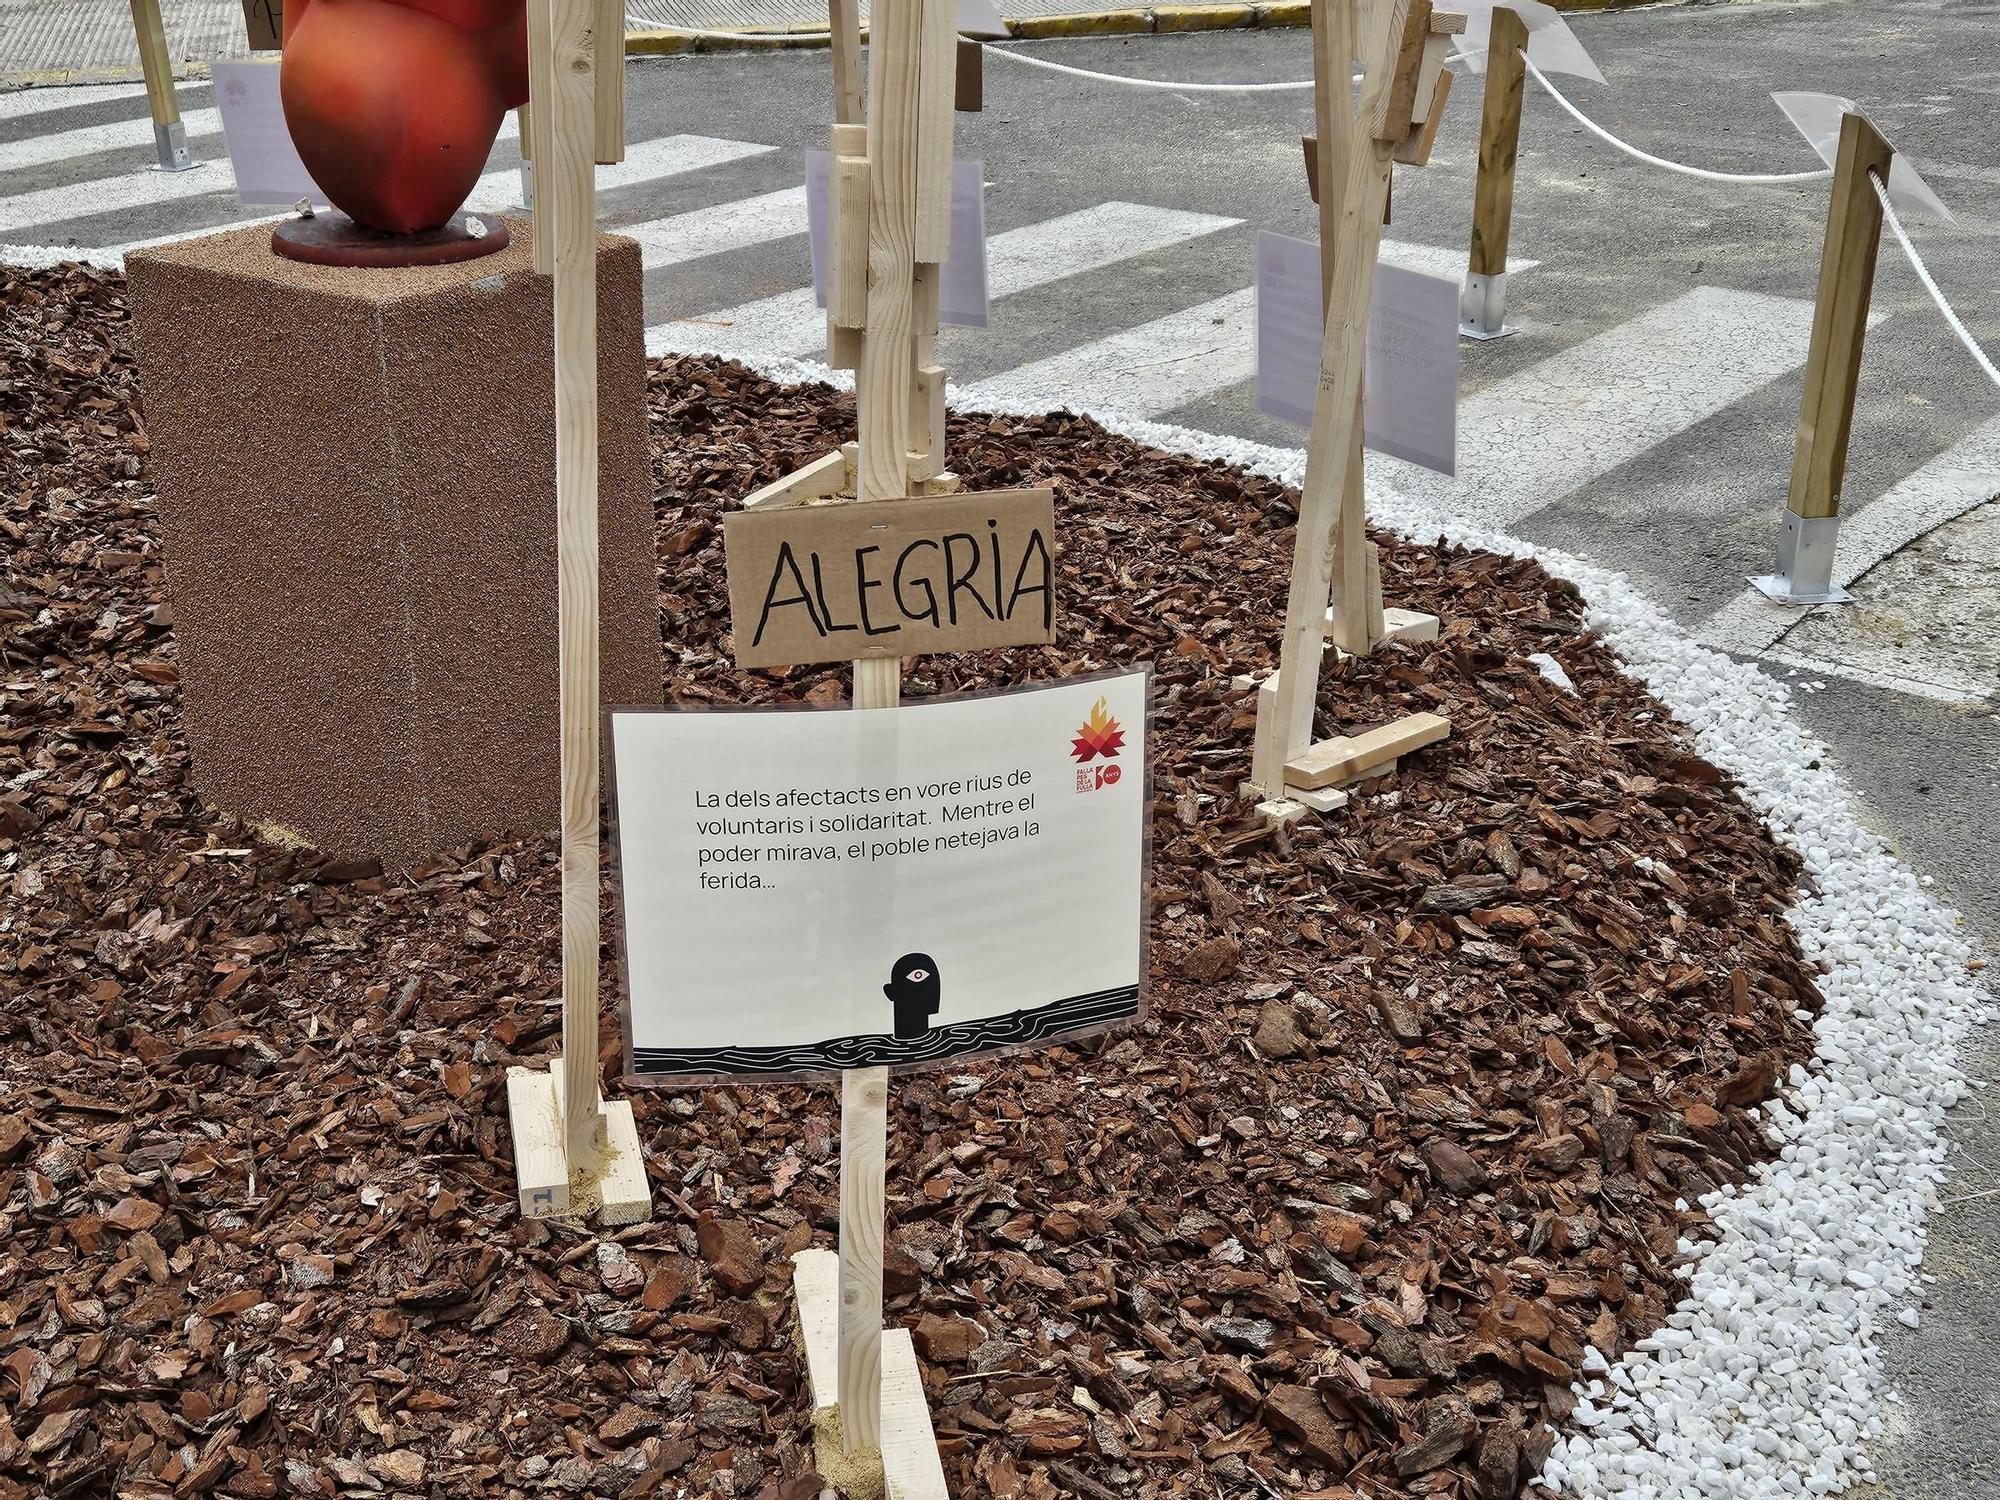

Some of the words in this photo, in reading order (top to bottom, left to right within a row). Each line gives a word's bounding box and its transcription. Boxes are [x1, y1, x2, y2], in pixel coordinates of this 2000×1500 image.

[696, 790, 720, 807] La
[725, 790, 770, 807] dels
[776, 787, 880, 807] afectacts
[885, 786, 911, 801] en
[917, 780, 961, 798] vore
[966, 775, 1003, 792] rius
[1007, 769, 1032, 786] de
[696, 817, 804, 835] voluntaris
[809, 816, 814, 833] i
[819, 809, 932, 832] solidaritat.
[942, 800, 1013, 823] Mentre
[1018, 793, 1034, 811] el
[699, 845, 761, 867] poder
[767, 844, 841, 862] mirava,
[847, 841, 866, 858] el
[872, 836, 930, 861] poble
[935, 825, 1019, 850] netejava
[1024, 820, 1040, 837] la
[700, 872, 776, 889] ferida...
